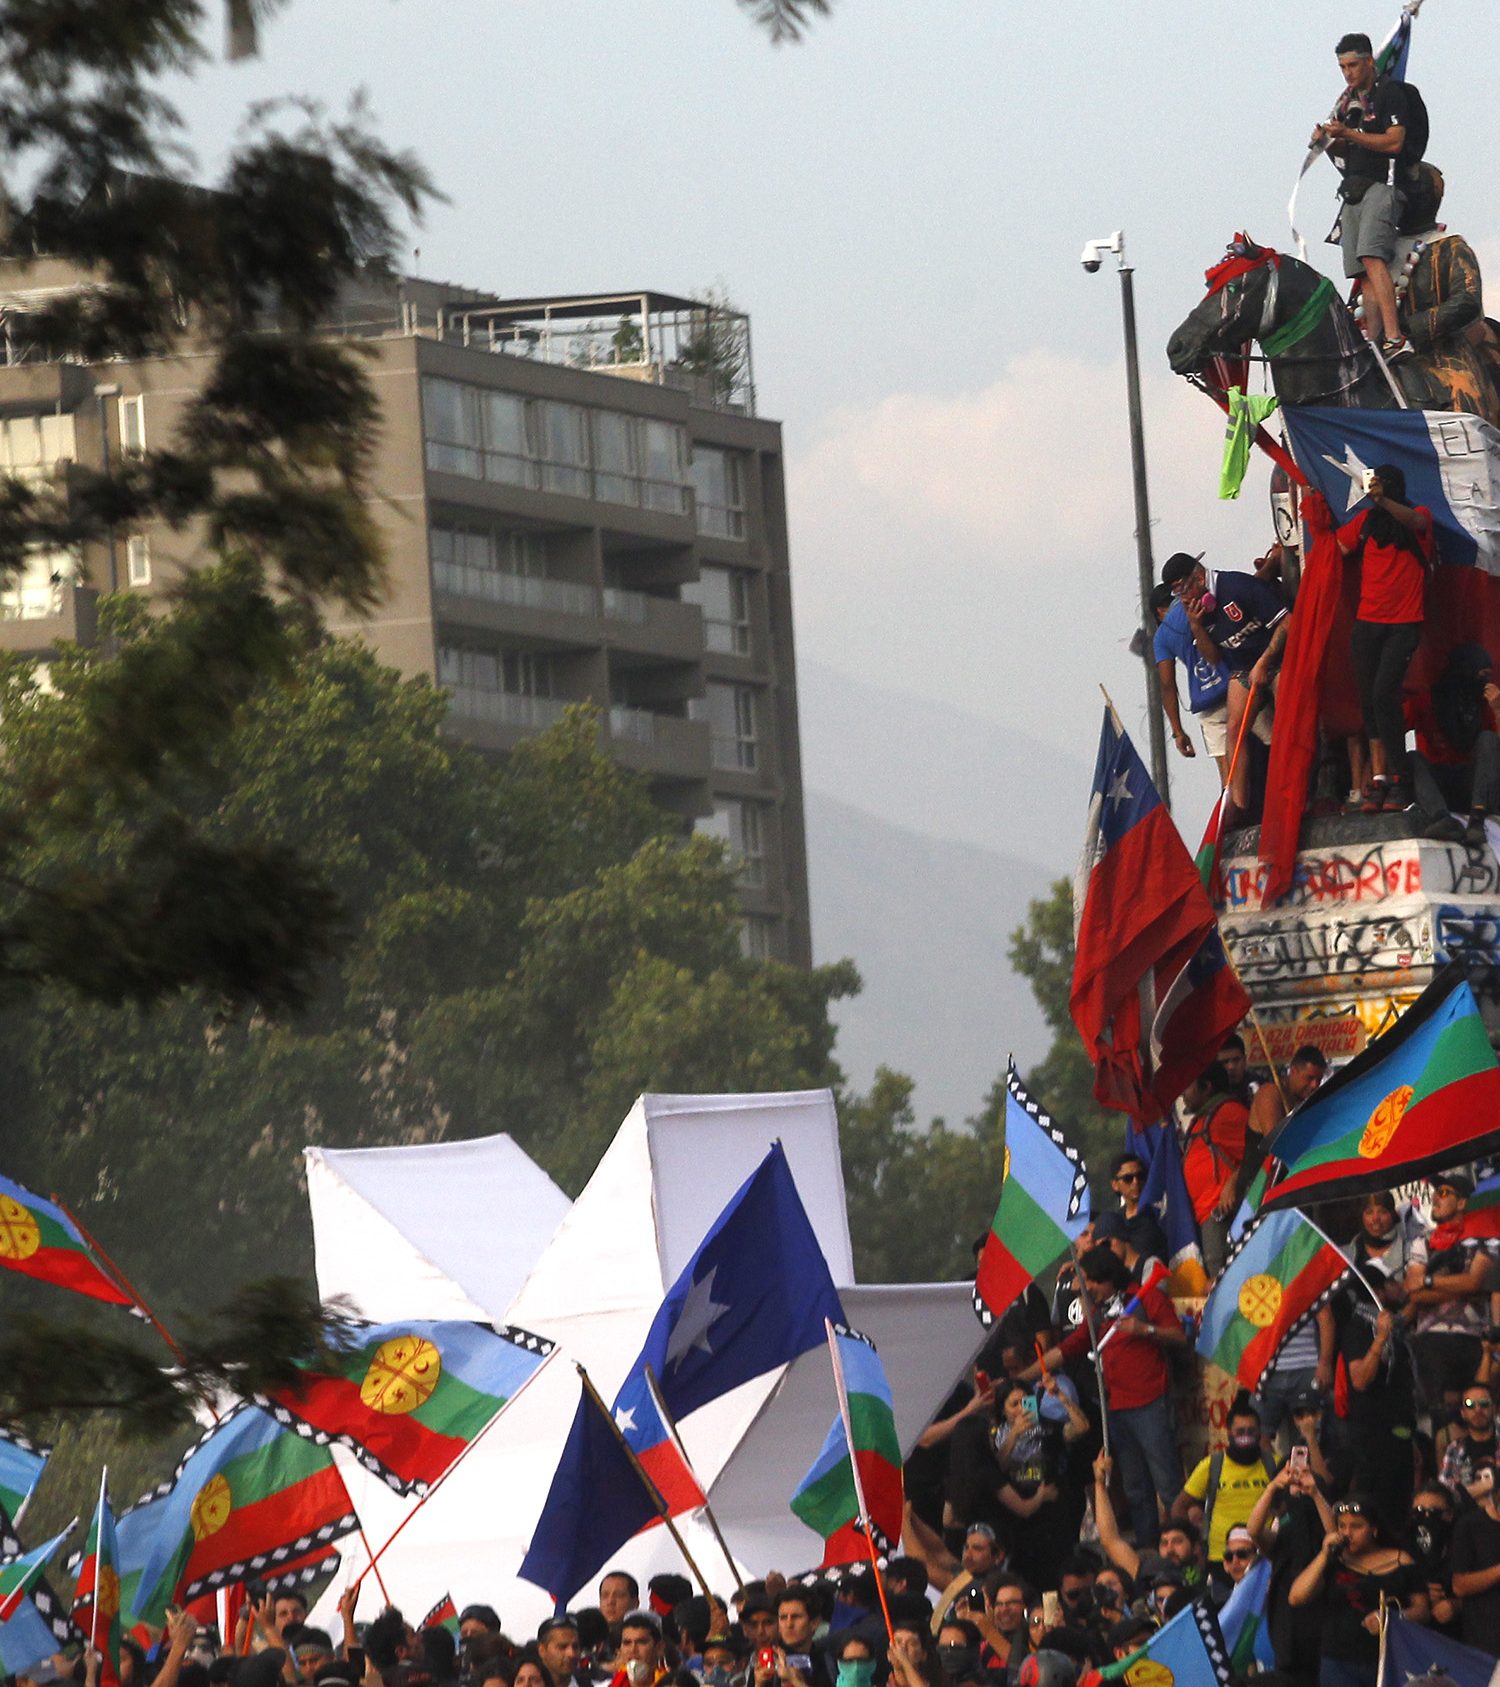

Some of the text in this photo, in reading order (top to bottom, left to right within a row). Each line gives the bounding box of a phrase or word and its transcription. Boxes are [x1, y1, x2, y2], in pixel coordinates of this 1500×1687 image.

[1438, 420, 1486, 457] EL
[1446, 473, 1485, 502] LA
[1250, 1026, 1293, 1045] PAZA
